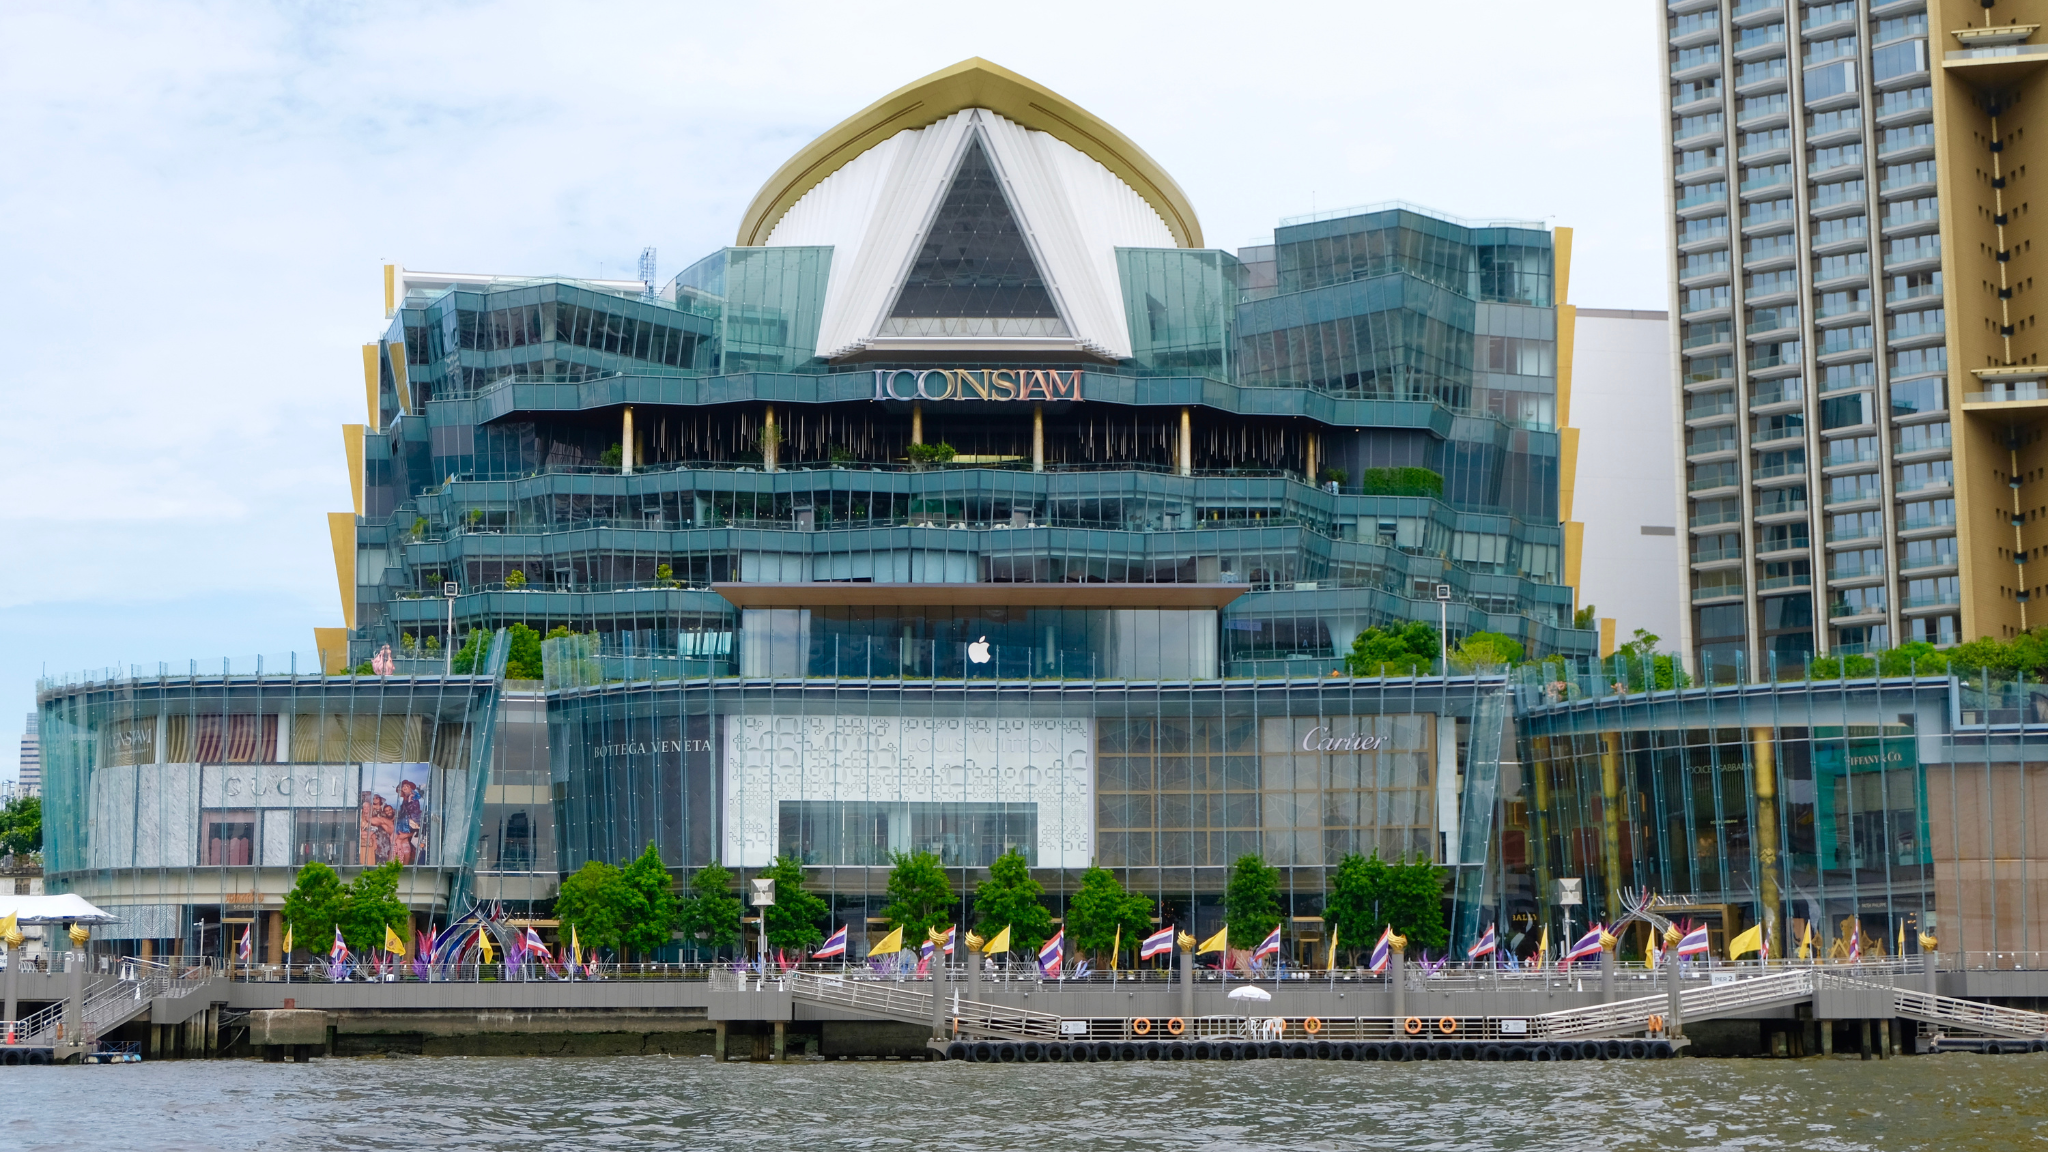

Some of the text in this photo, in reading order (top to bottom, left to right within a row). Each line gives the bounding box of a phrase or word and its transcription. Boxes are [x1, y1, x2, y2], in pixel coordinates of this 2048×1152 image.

[872, 368, 1085, 401] ICONSIAM
[907, 737, 1060, 753] LOUIS VUITTON
[1302, 726, 1389, 751] Cartier
[594, 739, 712, 759] BOTTEGA VENETA
[224, 776, 338, 797] GUCCI
[1504, 1023, 1510, 1031] 2
